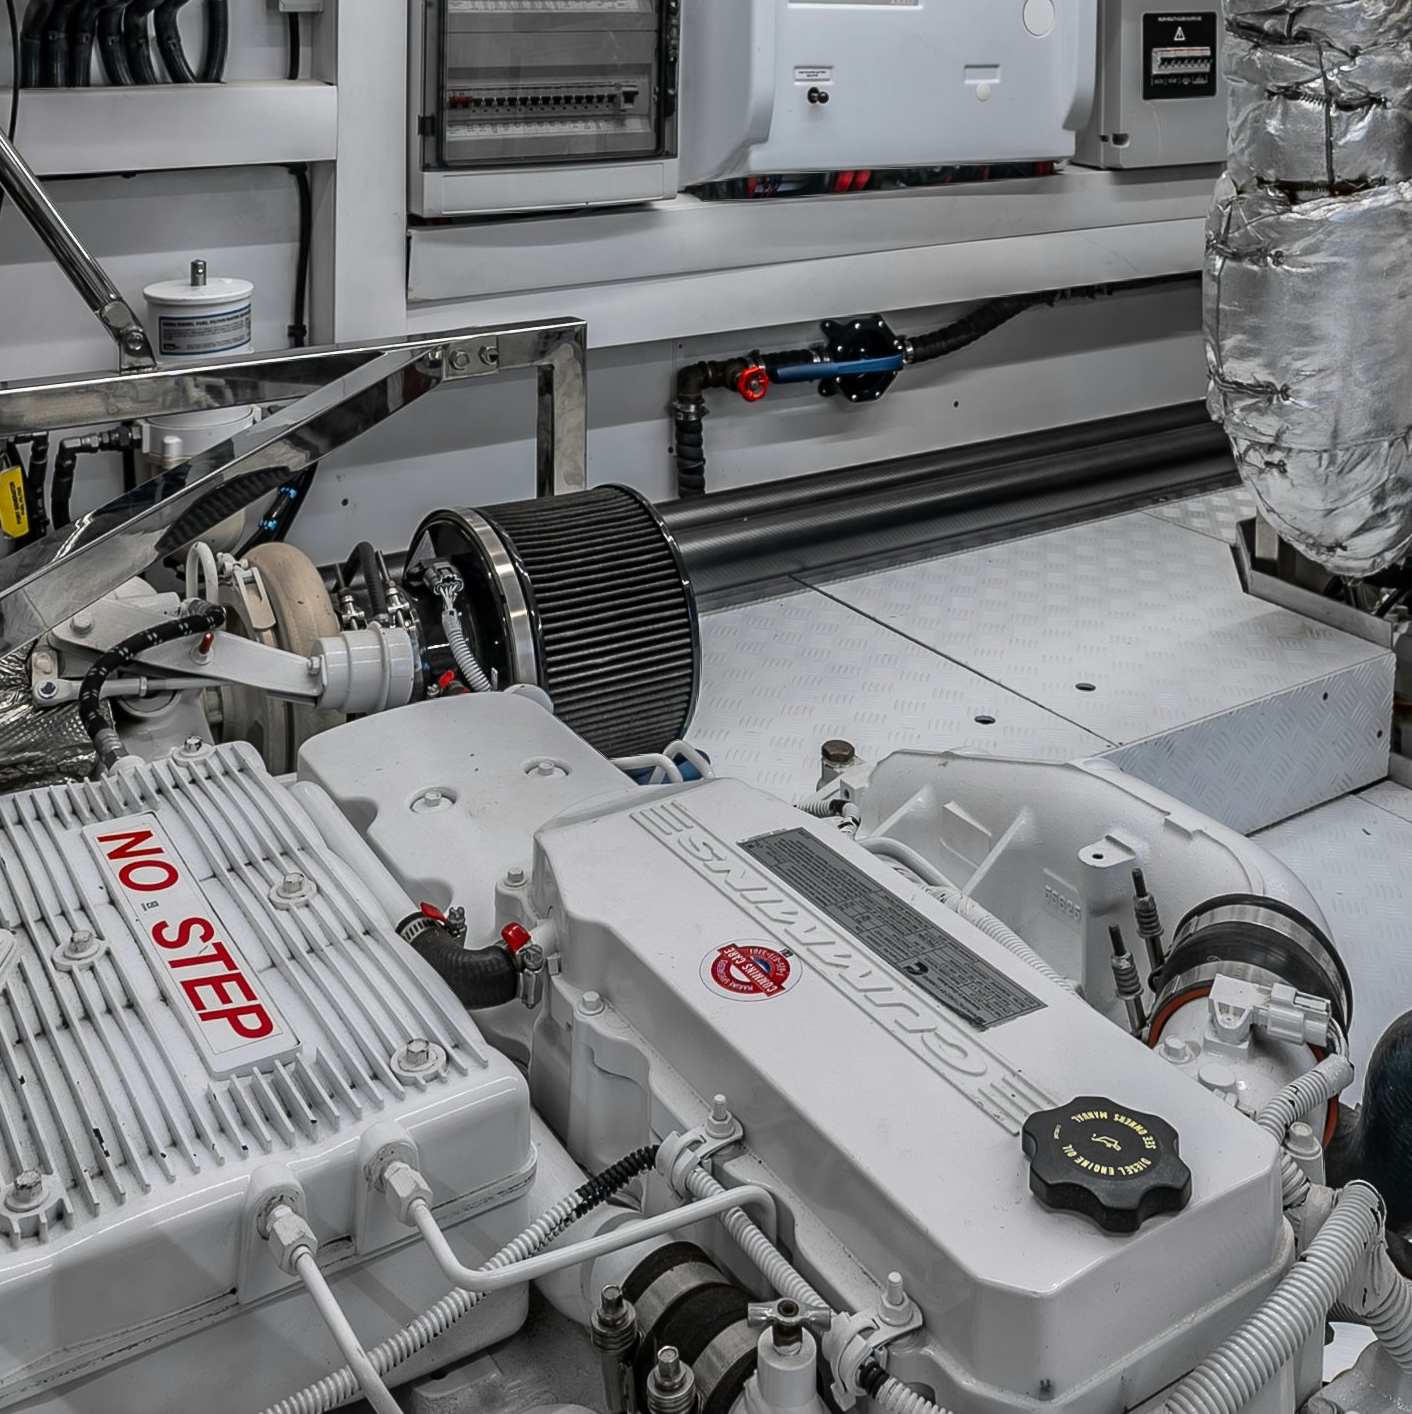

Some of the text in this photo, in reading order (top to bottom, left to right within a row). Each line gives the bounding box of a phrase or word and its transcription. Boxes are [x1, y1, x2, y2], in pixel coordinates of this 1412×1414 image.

[96, 829, 274, 1039] NO STEP
[677, 833, 988, 1077] CUMMINS
[723, 946, 747, 965] CARE
[742, 963, 778, 993] CUMMINS
[1070, 1110, 1157, 1150] SEE OWNERS MANUAL
[1062, 1144, 1152, 1176] DIESEL ENGINE OIL
